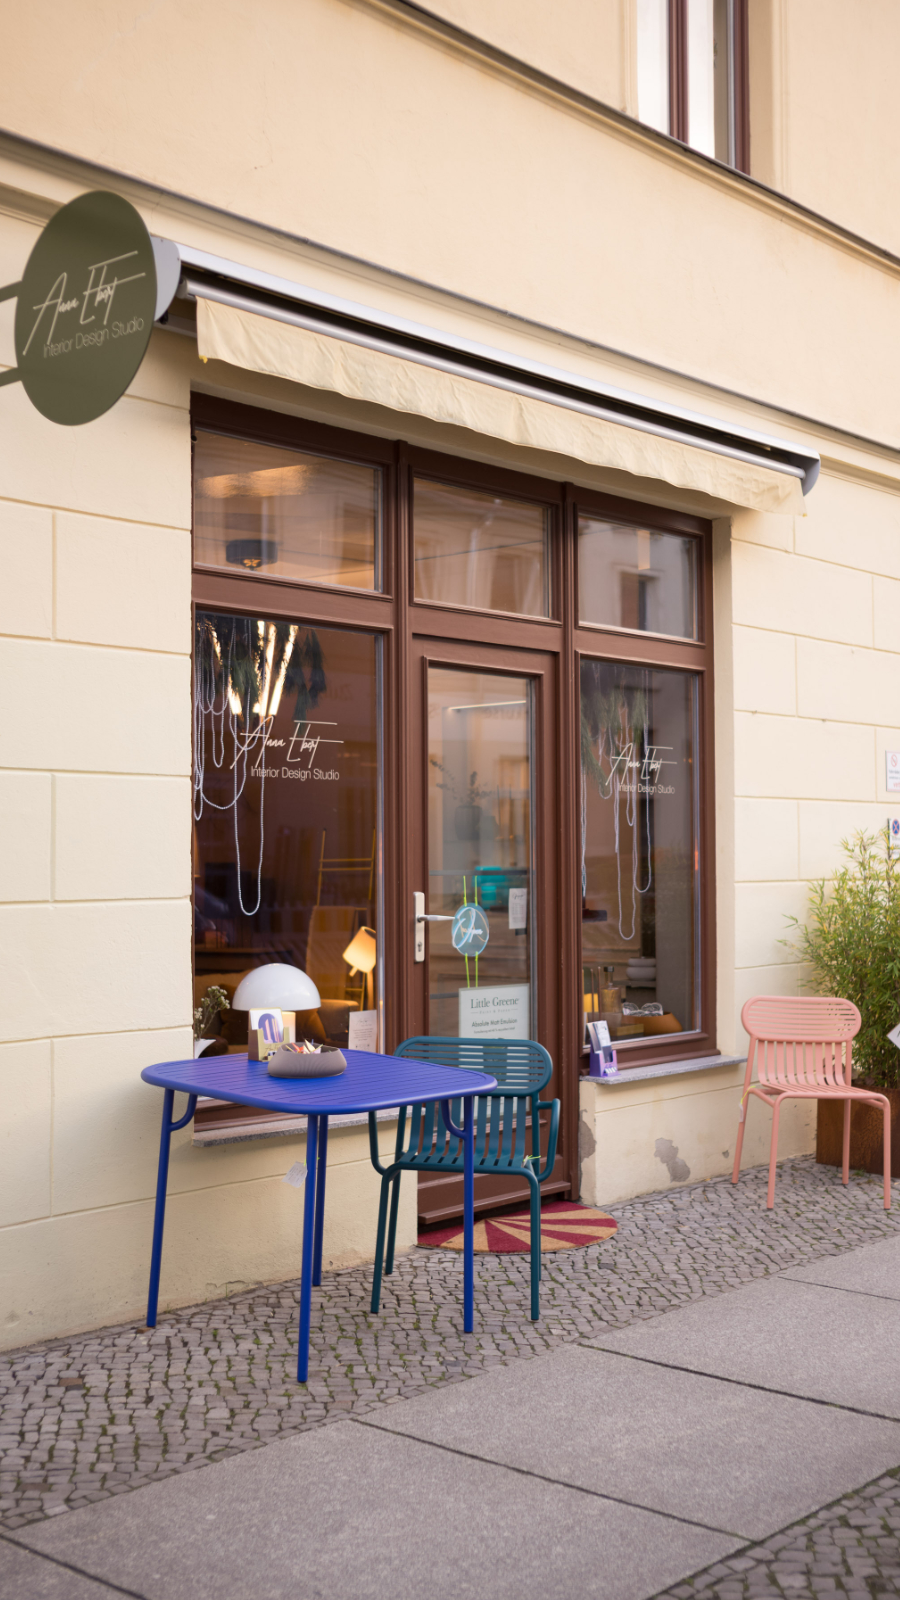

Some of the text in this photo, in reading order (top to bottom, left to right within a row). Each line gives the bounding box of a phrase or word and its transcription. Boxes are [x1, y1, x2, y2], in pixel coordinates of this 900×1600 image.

[43, 315, 145, 358] Interior Design Studio
[250, 765, 340, 781] Interior Design Studio
[619, 783, 676, 795] Interior Design Studio
[470, 996, 520, 1009] Little Greene
[472, 1020, 490, 1028] Absolute
